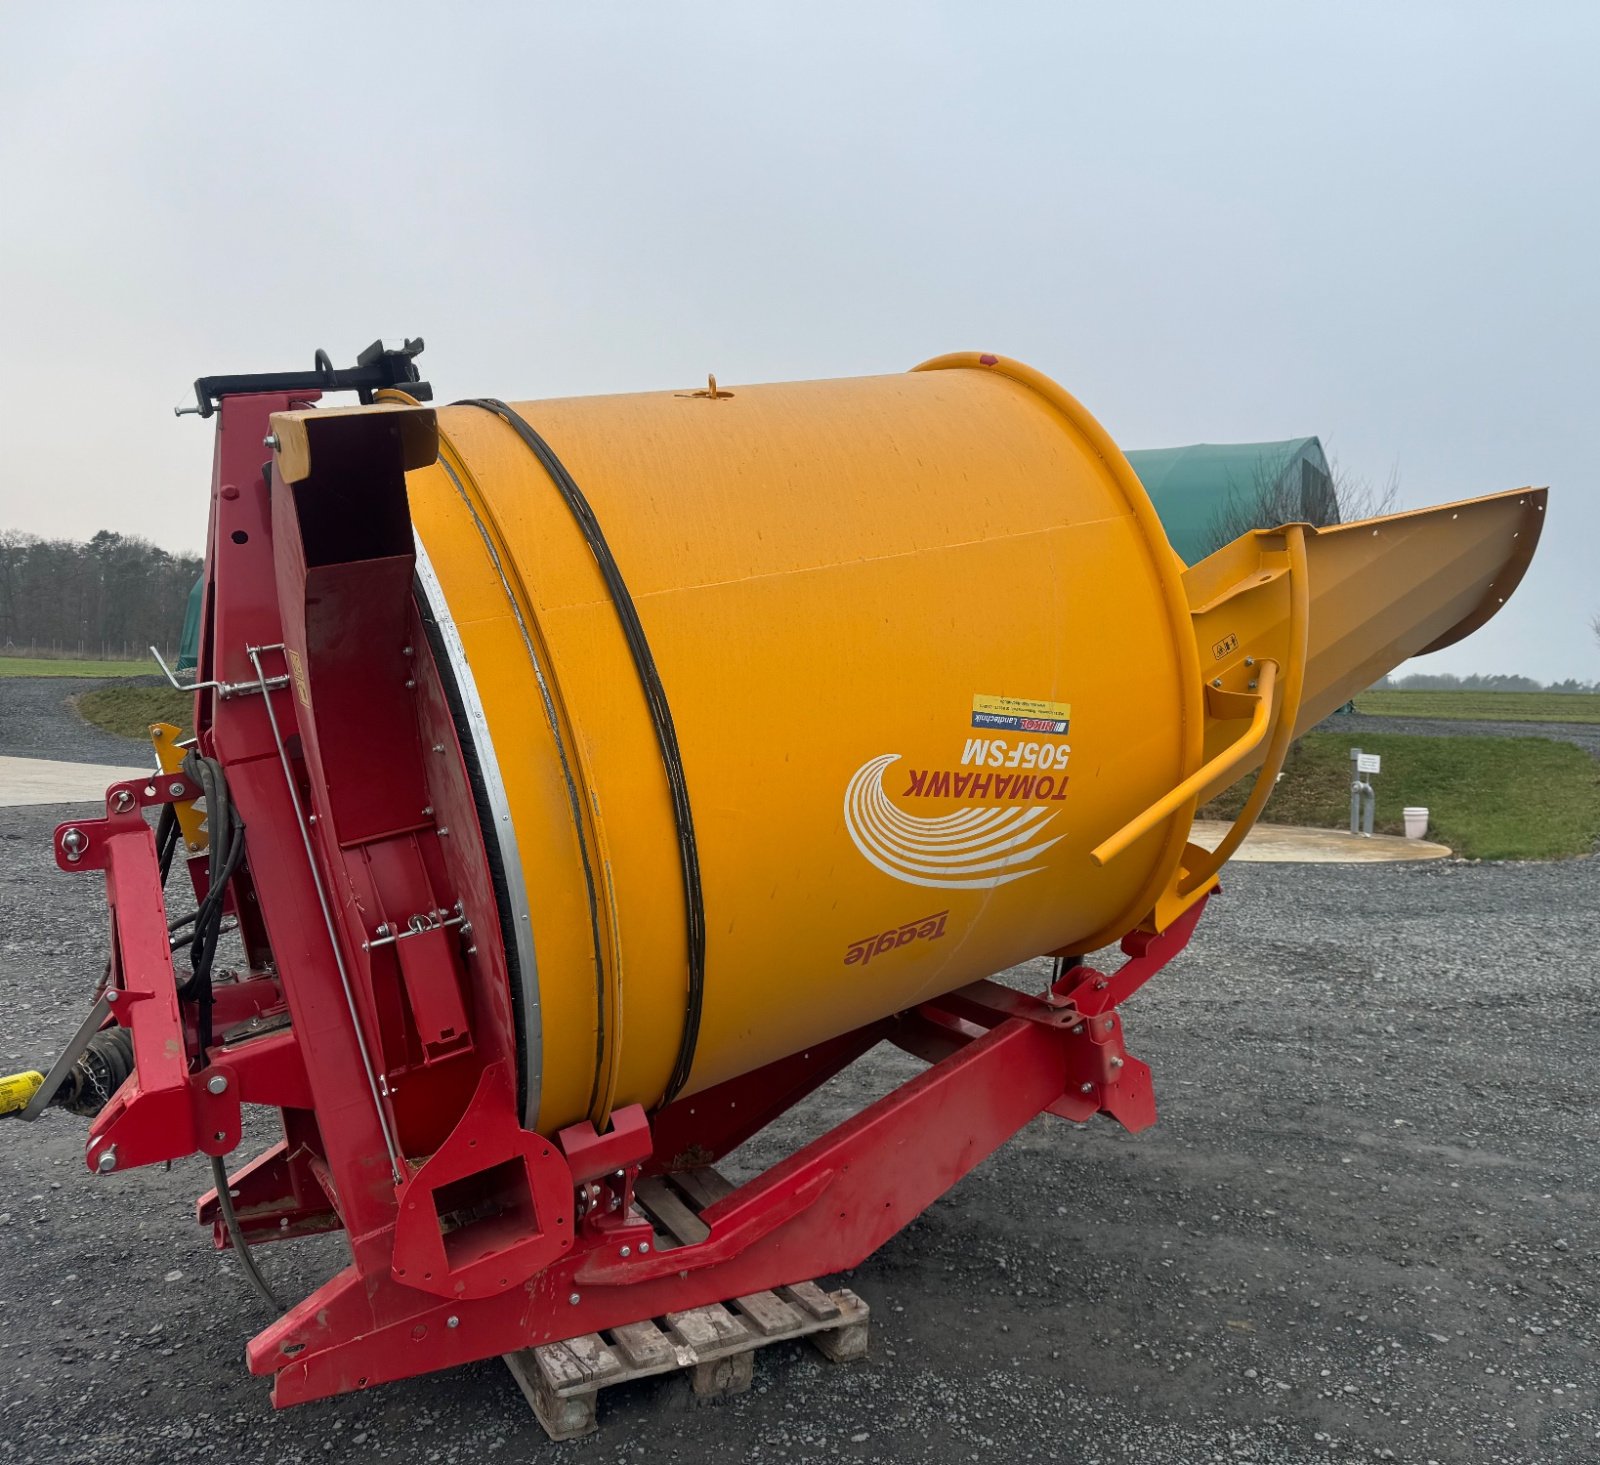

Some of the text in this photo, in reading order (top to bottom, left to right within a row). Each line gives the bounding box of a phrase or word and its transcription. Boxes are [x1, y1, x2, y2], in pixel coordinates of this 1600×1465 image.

[974, 714, 1018, 725] Landtechnik
[960, 738, 1071, 770] 505FSM
[902, 769, 1070, 800] TOMAHAWK
[843, 912, 949, 966] Teagle
